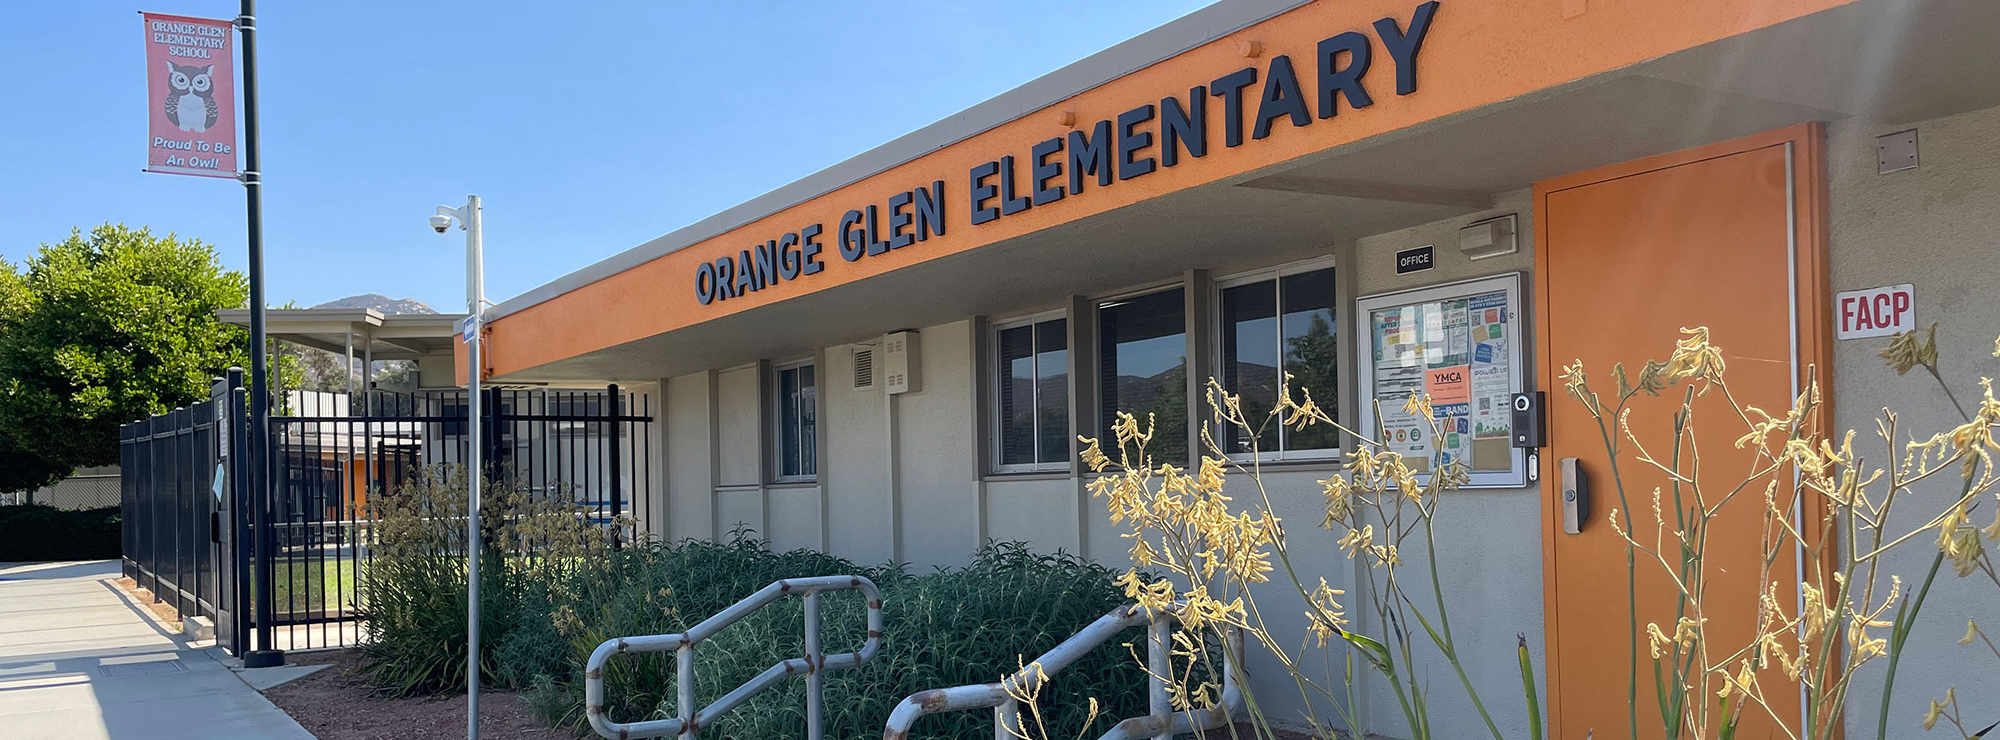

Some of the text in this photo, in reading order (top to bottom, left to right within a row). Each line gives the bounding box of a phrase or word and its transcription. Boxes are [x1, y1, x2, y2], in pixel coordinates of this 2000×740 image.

[152, 21, 225, 37] ORANGE GLEN
[154, 32, 225, 49] ELEMENTARY
[169, 45, 211, 59] SCHOOL
[153, 136, 231, 154] Proud To Be
[695, 0, 1440, 305] ORANGE GLEN ELEMENTARY
[166, 154, 219, 169] An Owl!
[1400, 253, 1429, 267] OFFICE
[1841, 291, 1909, 332] FACP
[1434, 371, 1462, 383] YMCA
[1445, 404, 1469, 415] BAND
